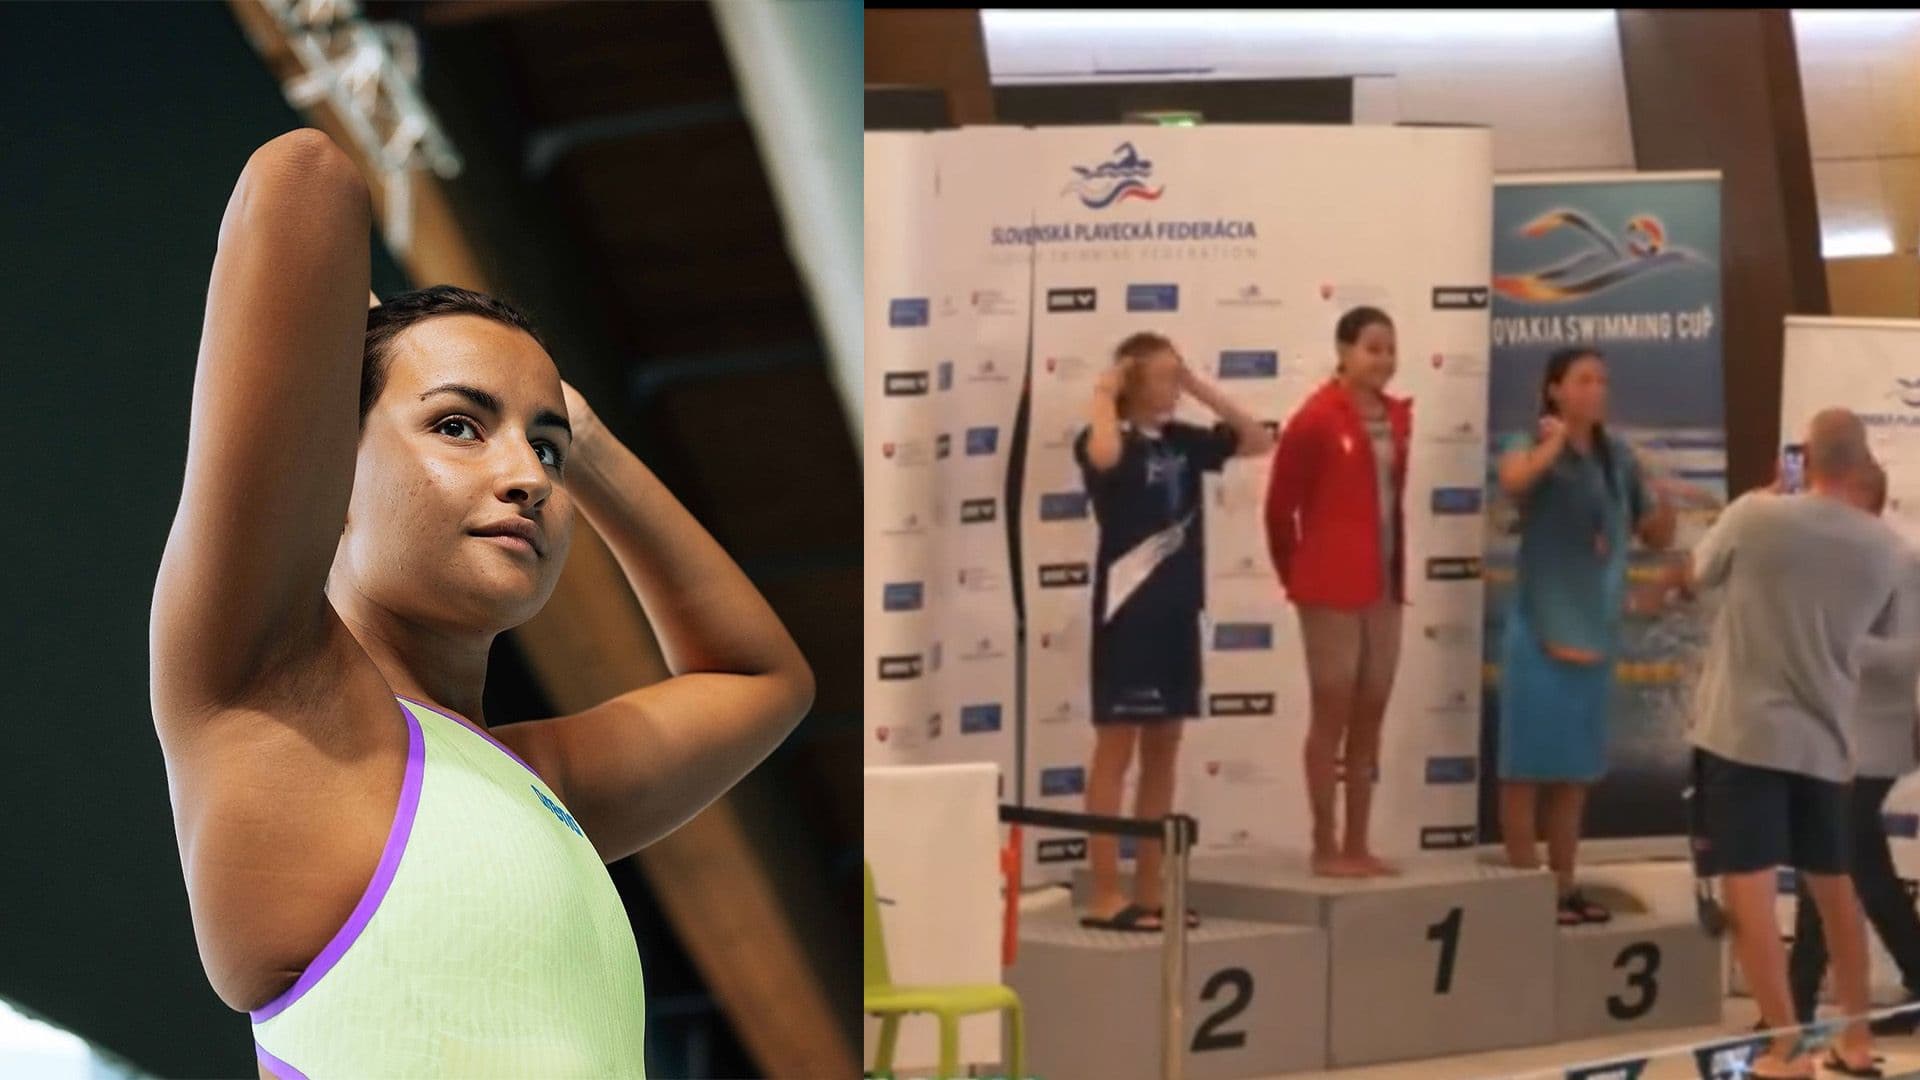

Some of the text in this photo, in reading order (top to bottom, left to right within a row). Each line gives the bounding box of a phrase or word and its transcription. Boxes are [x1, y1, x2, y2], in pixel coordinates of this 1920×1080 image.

[1075, 220, 1153, 242] PLAVECKÁ
[1157, 218, 1257, 241] FEDERÁCIA
[1566, 314, 1671, 342] SWIMMING
[1676, 309, 1713, 338] CUP
[1426, 907, 1464, 994] 1
[1607, 942, 1661, 1020] 3
[1191, 967, 1254, 1051] 2
